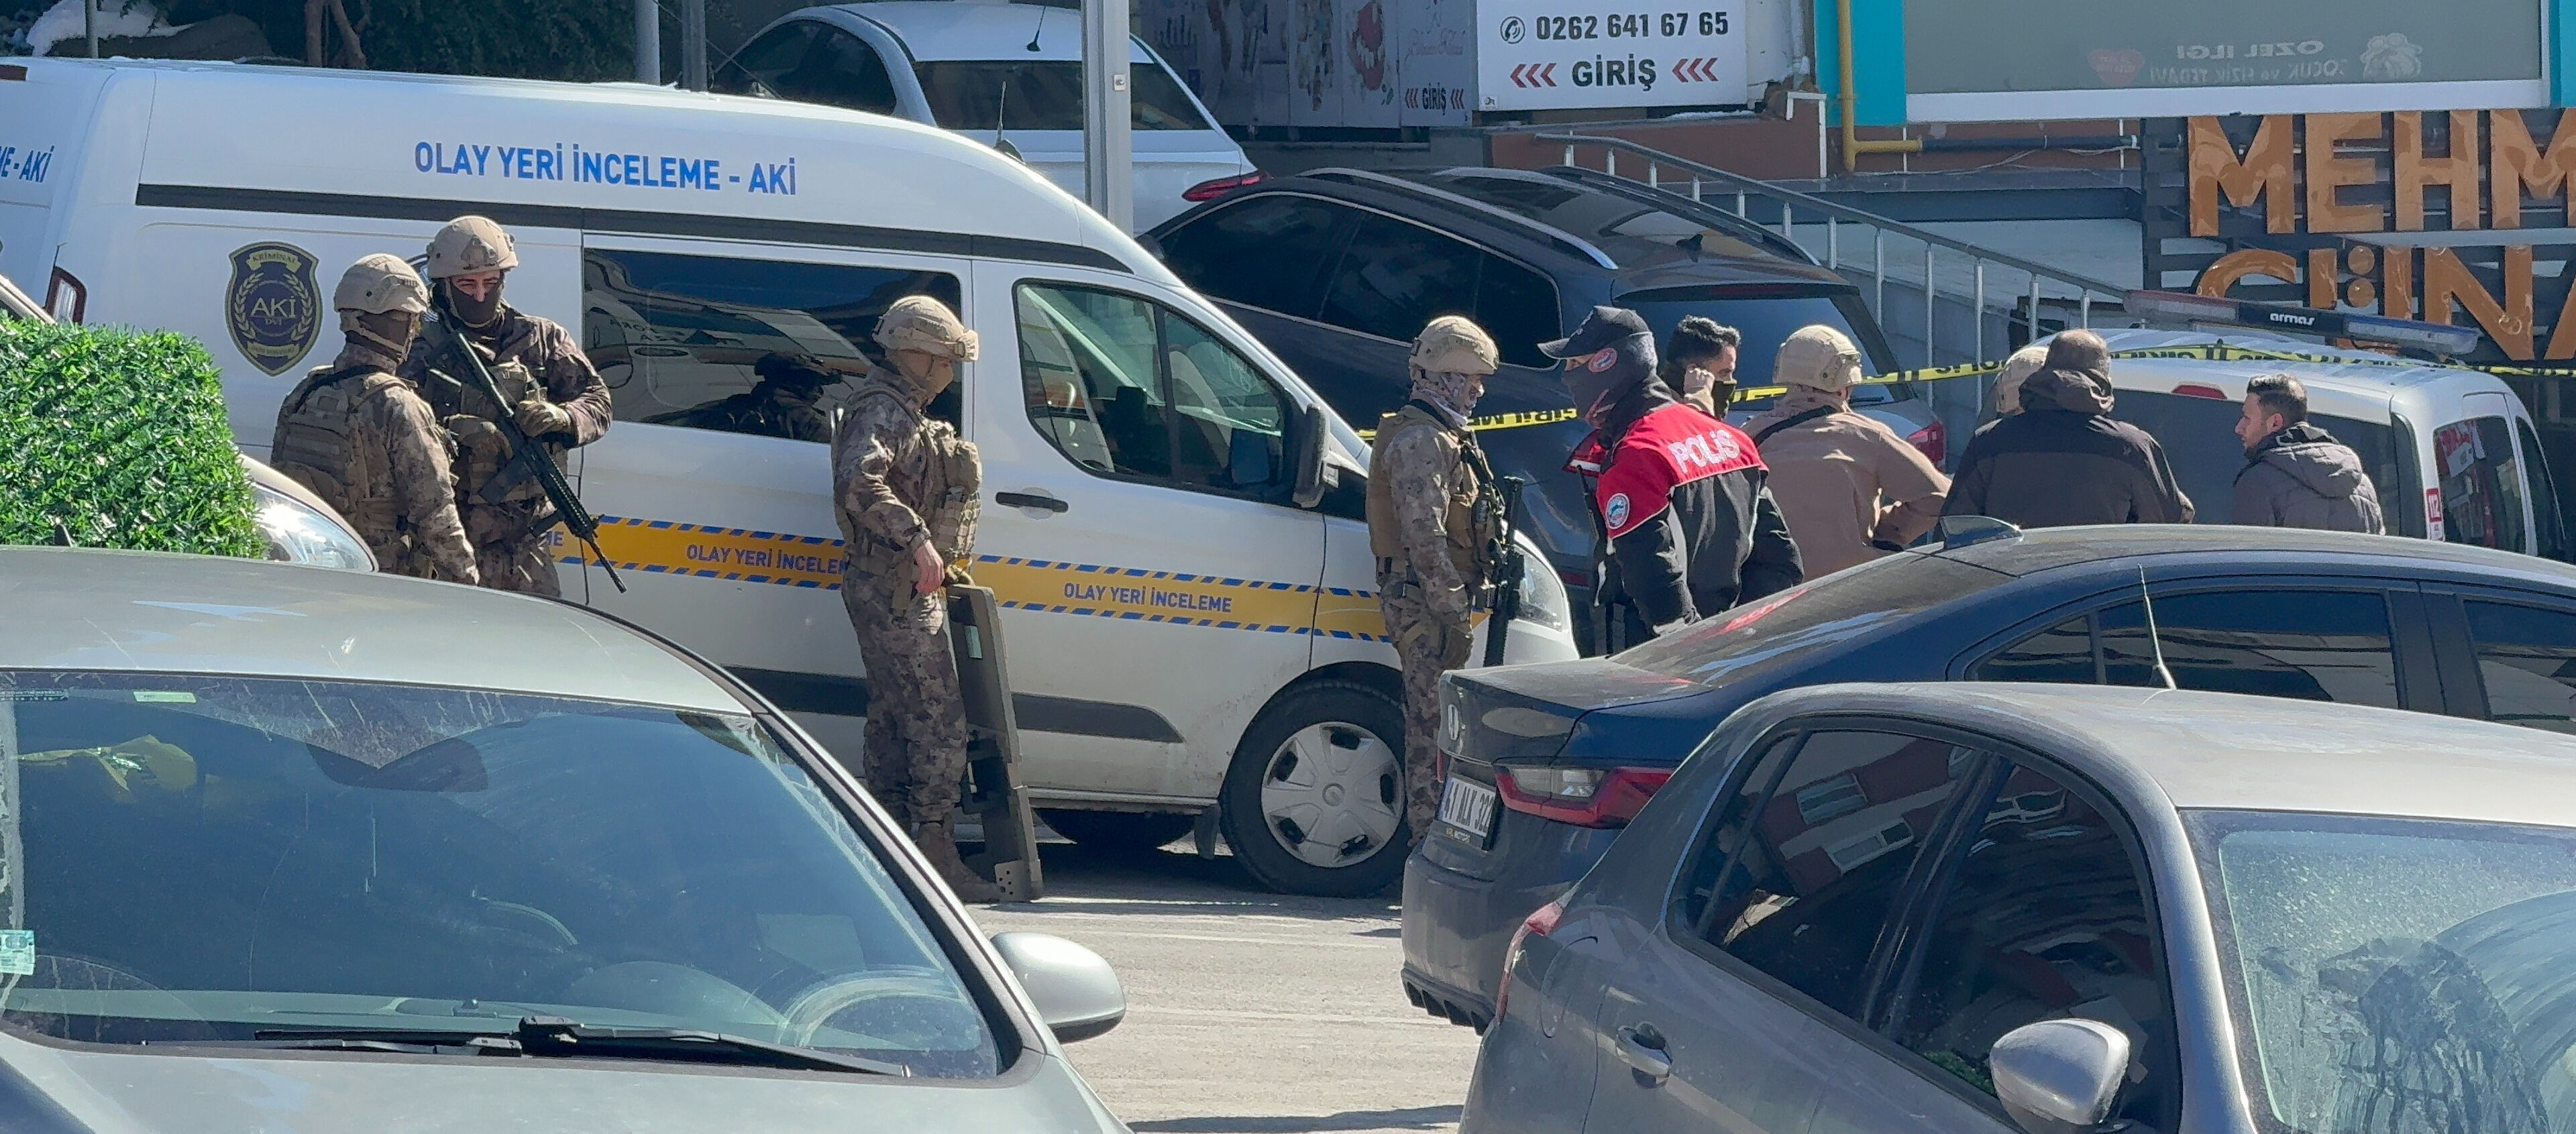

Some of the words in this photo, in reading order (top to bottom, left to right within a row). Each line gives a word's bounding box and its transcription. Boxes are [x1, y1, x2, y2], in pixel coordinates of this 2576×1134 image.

[1536, 16, 1598, 40] 0262
[1607, 13, 1650, 38] 641
[1660, 12, 1689, 37] 67
[1699, 11, 1729, 36] 65
[1572, 54, 1656, 92] GİRİŞ
[1422, 82, 1447, 115] GİRİŞ
[19, 145, 55, 182] AKİ
[415, 141, 490, 176] OLAY
[496, 142, 563, 181] YERİ
[572, 143, 720, 190] İNCELEME
[747, 157, 796, 196] AKİ
[250, 295, 297, 318] AKİ
[2269, 313, 2316, 326] armas
[686, 544, 731, 563] OLAY
[735, 548, 773, 568] YERİ
[1064, 582, 1107, 602] OLAY
[1110, 586, 1146, 606] YERİ
[1149, 587, 1232, 613] İNCELEME
[1444, 781, 1459, 820] 41
[1474, 793, 1494, 833] 322
